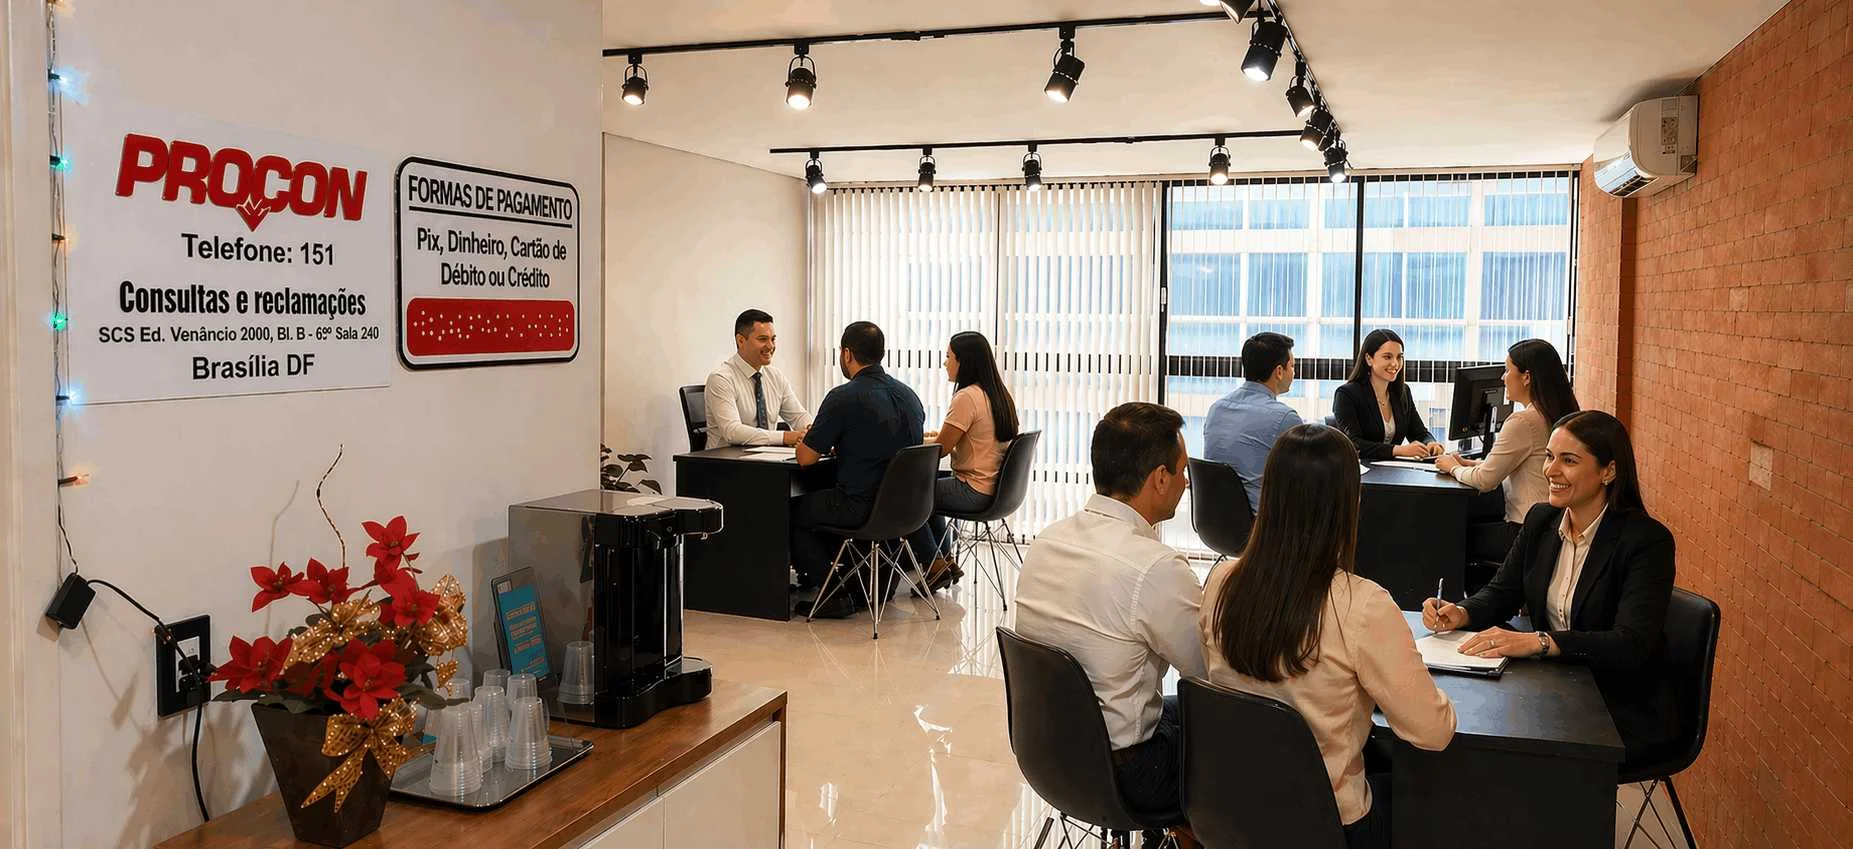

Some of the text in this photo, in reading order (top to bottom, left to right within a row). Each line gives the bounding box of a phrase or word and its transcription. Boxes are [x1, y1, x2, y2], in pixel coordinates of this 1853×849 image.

[115, 133, 367, 222] PROCON
[408, 175, 573, 220] FORMAS DE PAGAMENTO
[181, 233, 334, 265] Telefone: 151
[417, 227, 567, 260] Pix, Dinheiro, Cartão de
[440, 262, 550, 288] Débito ou Crédito
[119, 280, 366, 320] Consultas e reclamações
[98, 326, 135, 343] SCS
[140, 326, 165, 343] Ed.
[170, 326, 237, 342] Venâncio
[240, 326, 274, 343] 2000,
[277, 326, 293, 341] Bl.
[296, 326, 306, 341] B
[335, 326, 358, 340] Sala
[360, 326, 379, 340] 240
[192, 353, 315, 380] Brasília DF
